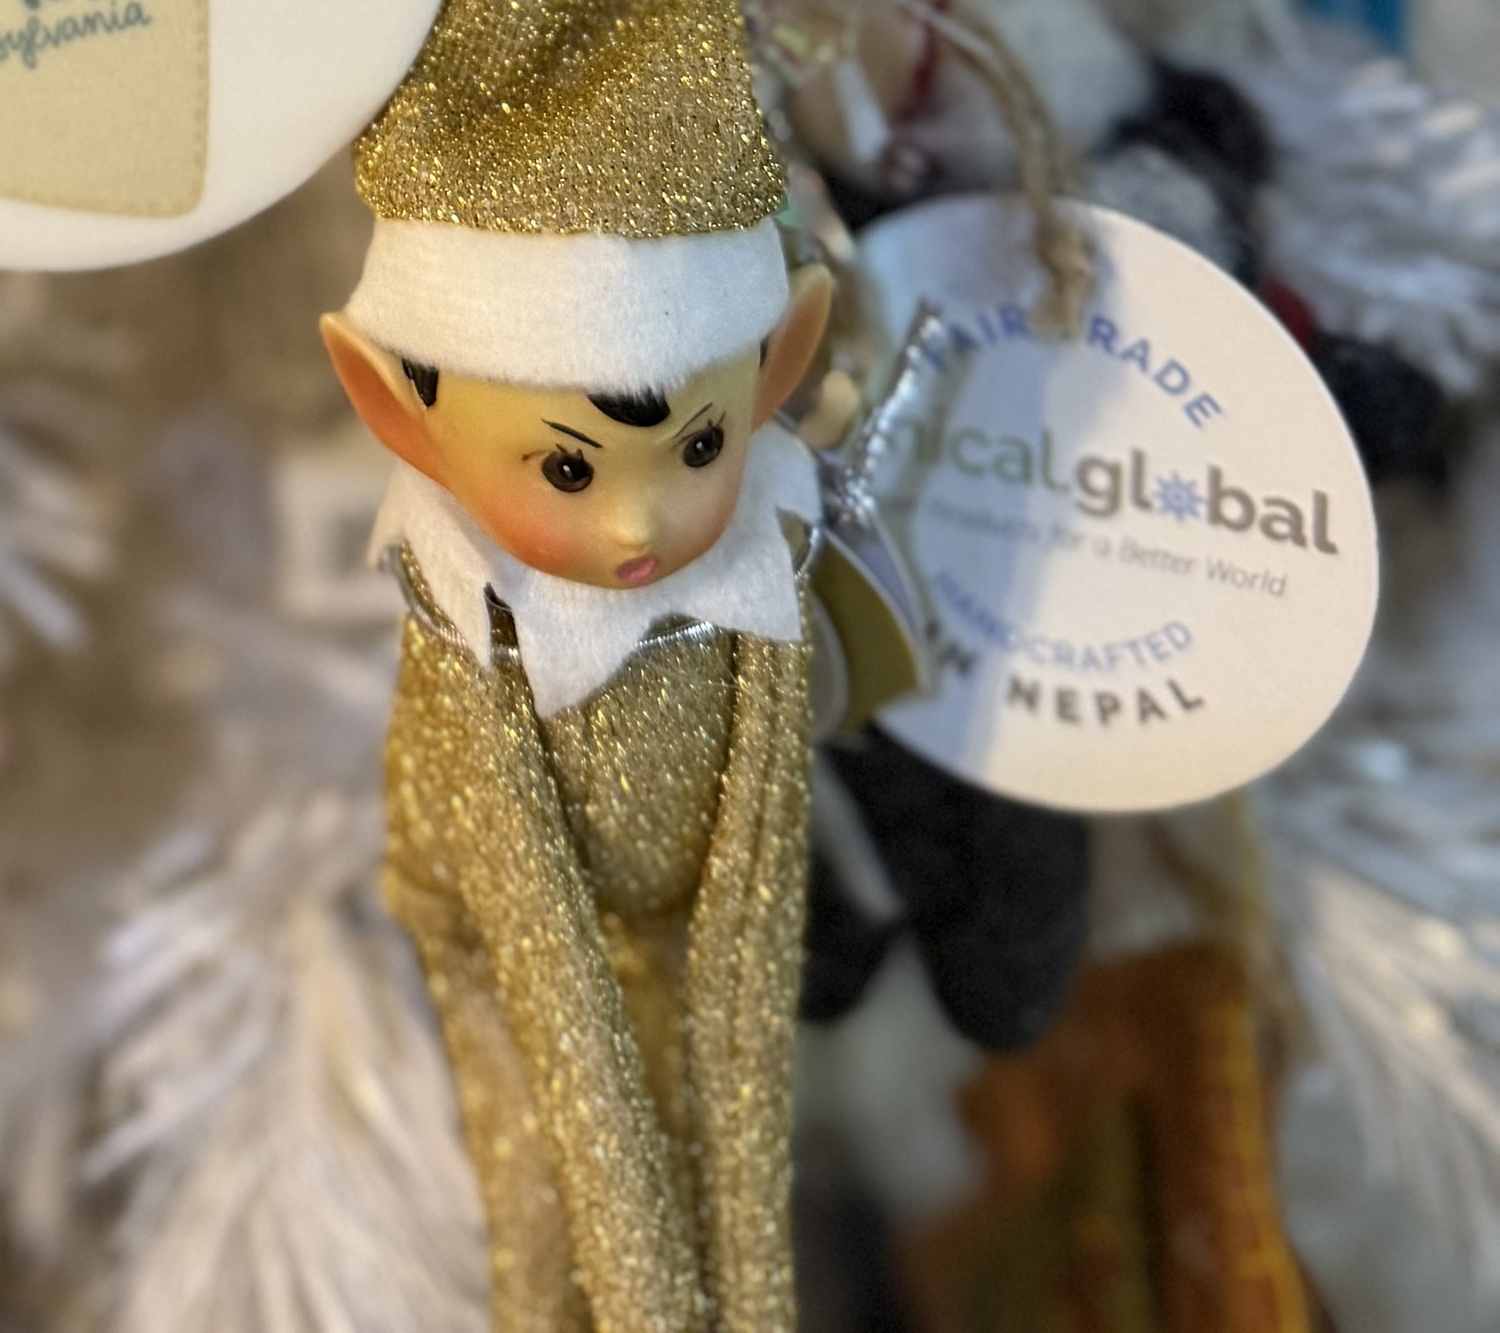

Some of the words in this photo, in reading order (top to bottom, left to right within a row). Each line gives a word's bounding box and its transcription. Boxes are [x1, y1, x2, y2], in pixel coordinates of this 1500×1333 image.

[1086, 315, 1223, 429] RADE
[1118, 535, 1196, 575] Better
[1205, 555, 1288, 598] World
[1007, 677, 1205, 727] NEPAL
